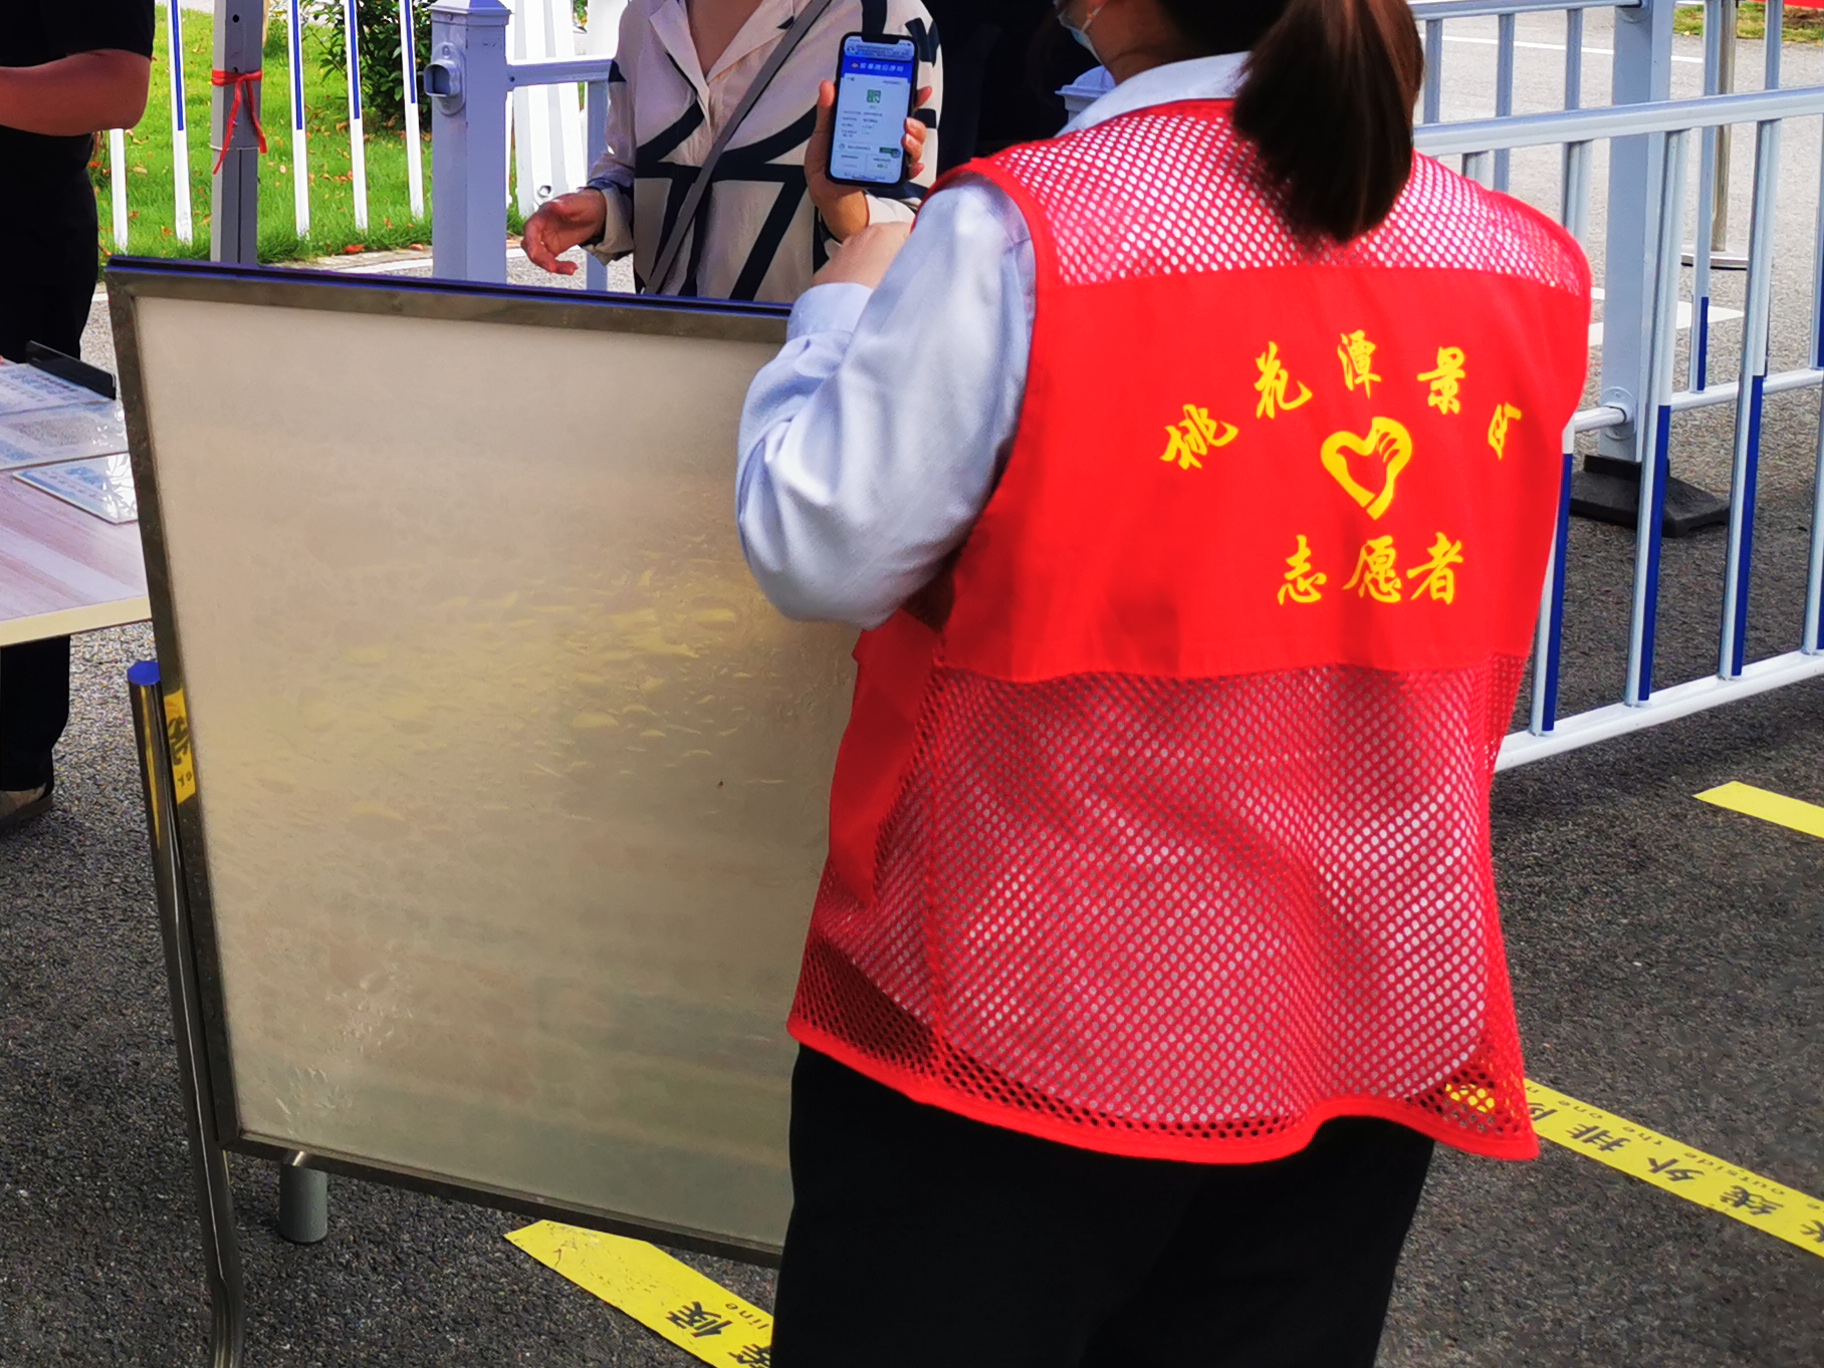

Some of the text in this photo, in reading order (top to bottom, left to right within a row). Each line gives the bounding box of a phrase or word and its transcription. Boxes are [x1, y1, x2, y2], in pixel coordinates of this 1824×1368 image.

[1278, 532, 1464, 605] 志愿者
[725, 1302, 770, 1330] line
